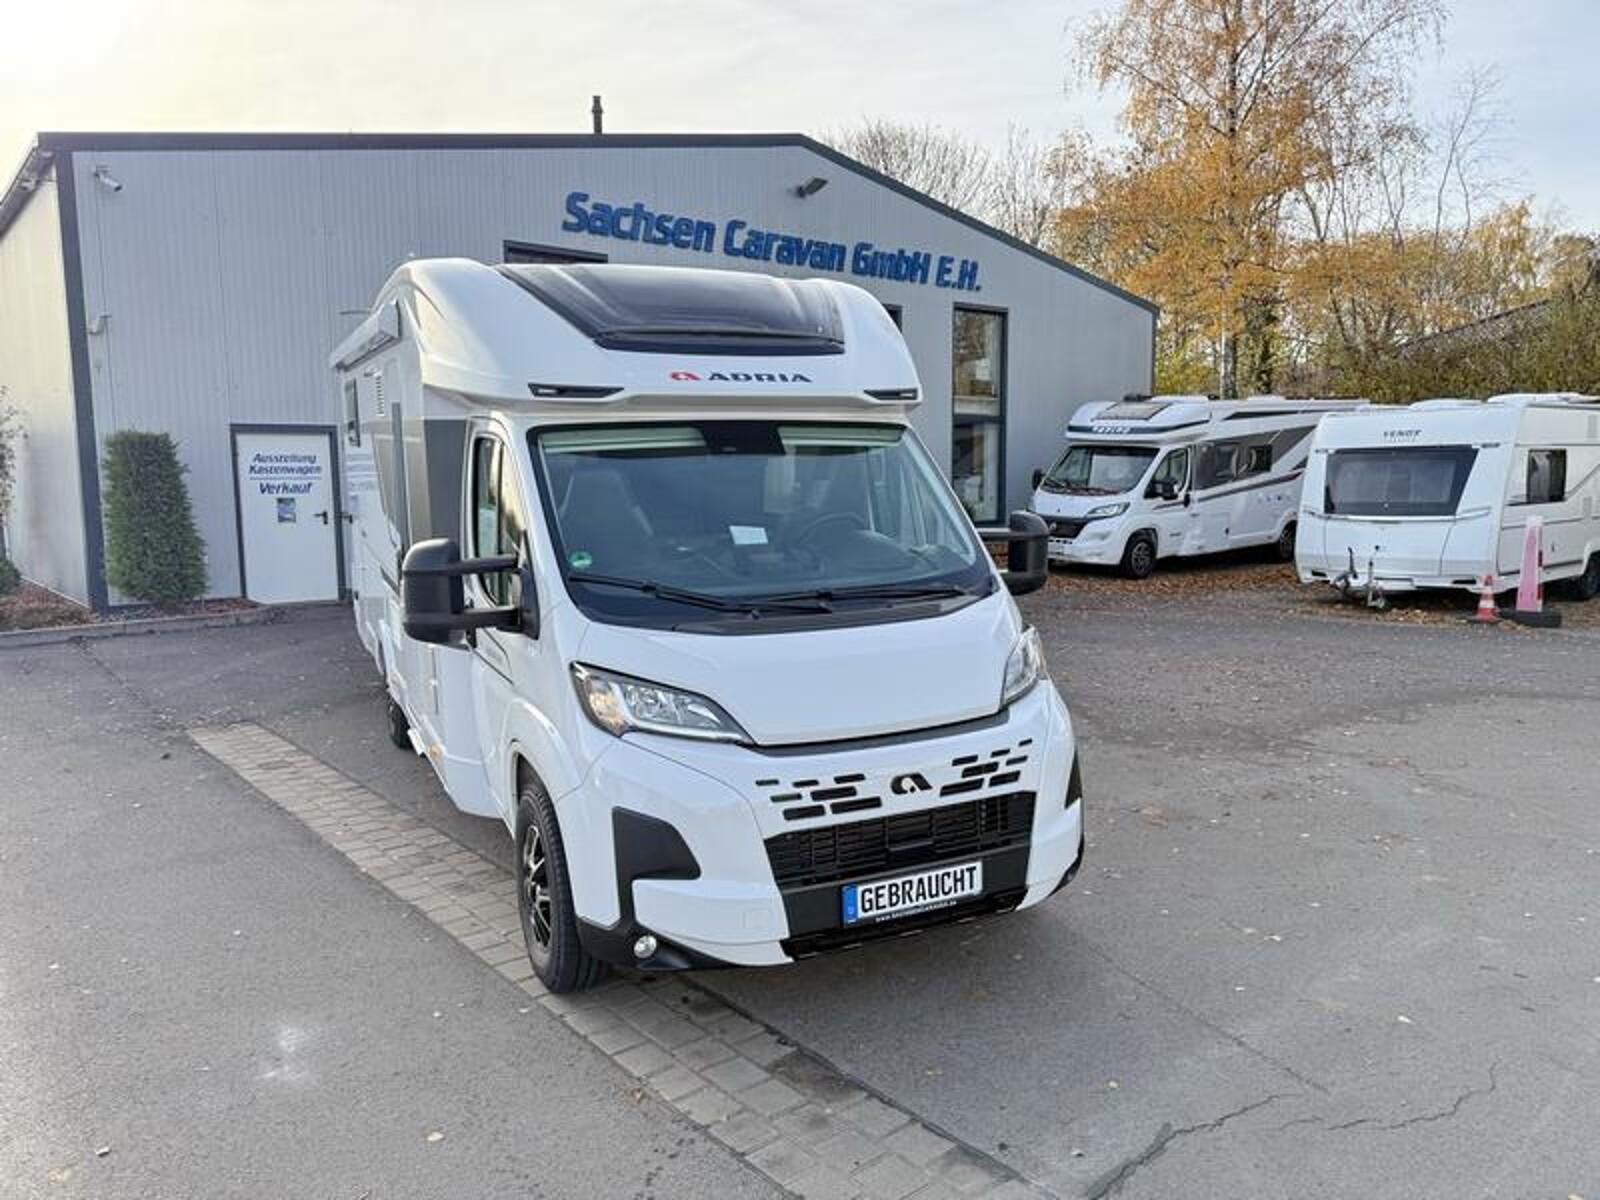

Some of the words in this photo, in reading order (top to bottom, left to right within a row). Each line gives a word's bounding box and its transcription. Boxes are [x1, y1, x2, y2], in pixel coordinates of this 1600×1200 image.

[562, 191, 716, 252] Sachsen
[723, 219, 846, 273] Caravan
[852, 241, 932, 286] GmbH
[936, 256, 982, 291] E.H.
[708, 371, 813, 383] ADRIA
[259, 482, 313, 494] Verkauf
[861, 866, 977, 913] GEBRAUCHT
